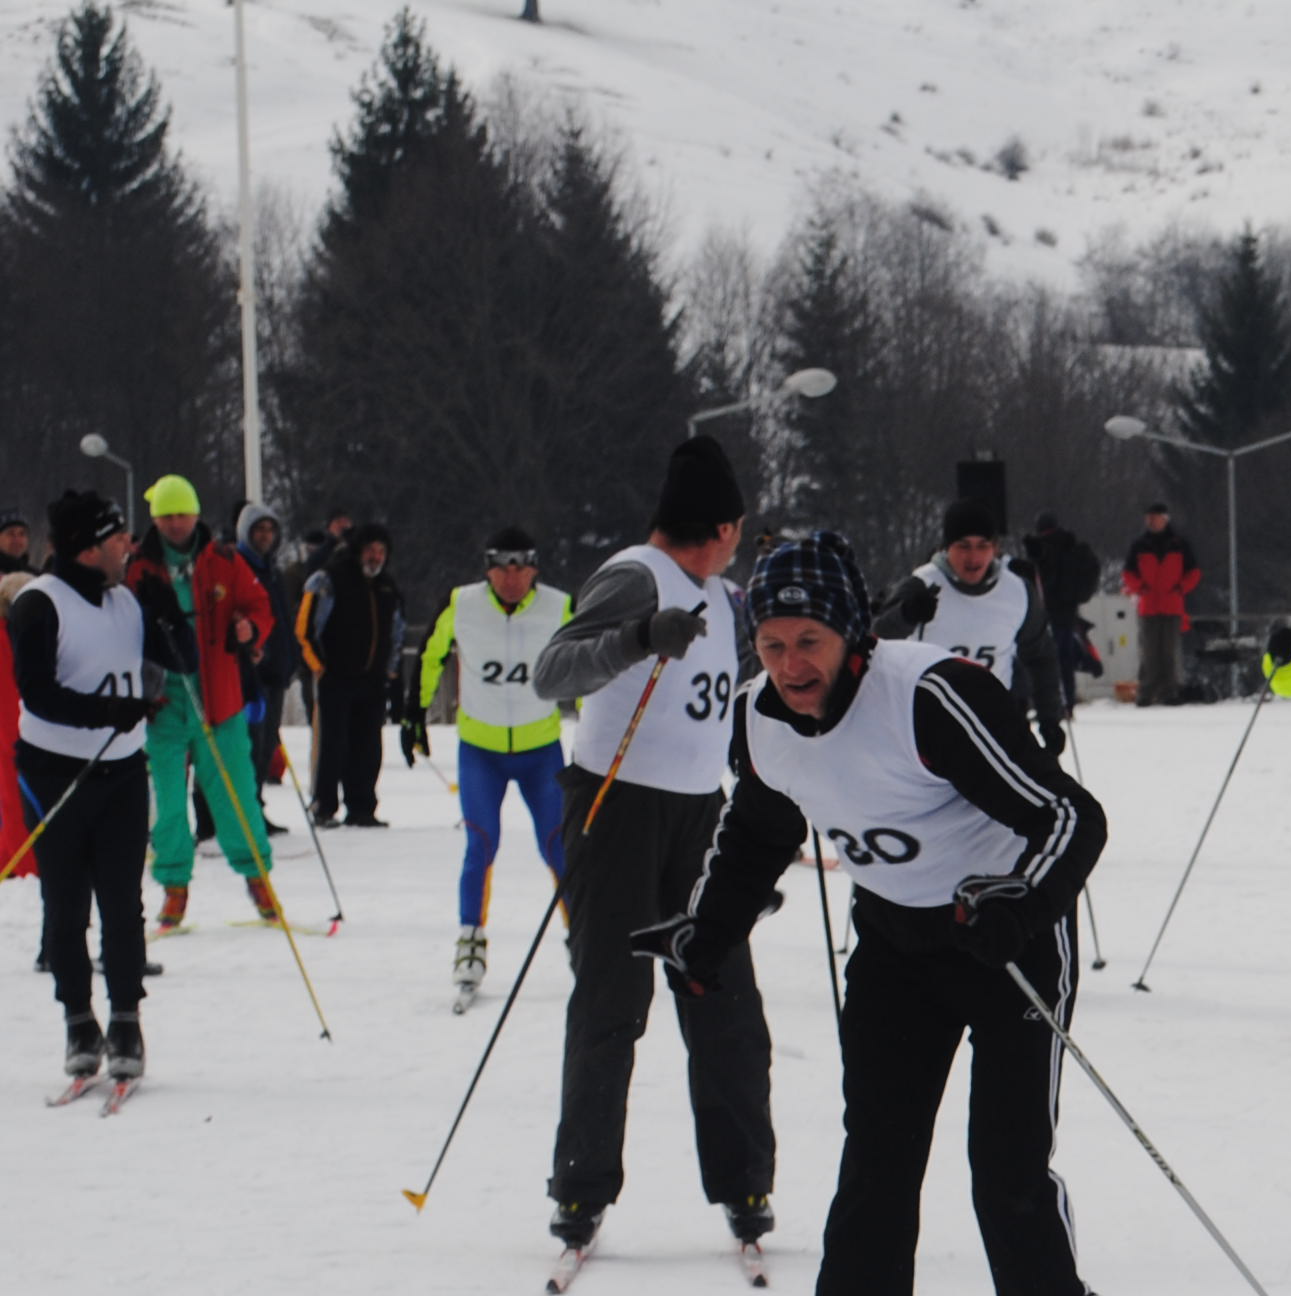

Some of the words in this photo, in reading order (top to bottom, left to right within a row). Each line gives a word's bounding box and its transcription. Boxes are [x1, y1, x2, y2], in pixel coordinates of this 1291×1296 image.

[481, 660, 530, 686] 24
[685, 671, 731, 722] 39
[827, 827, 922, 866] 30
